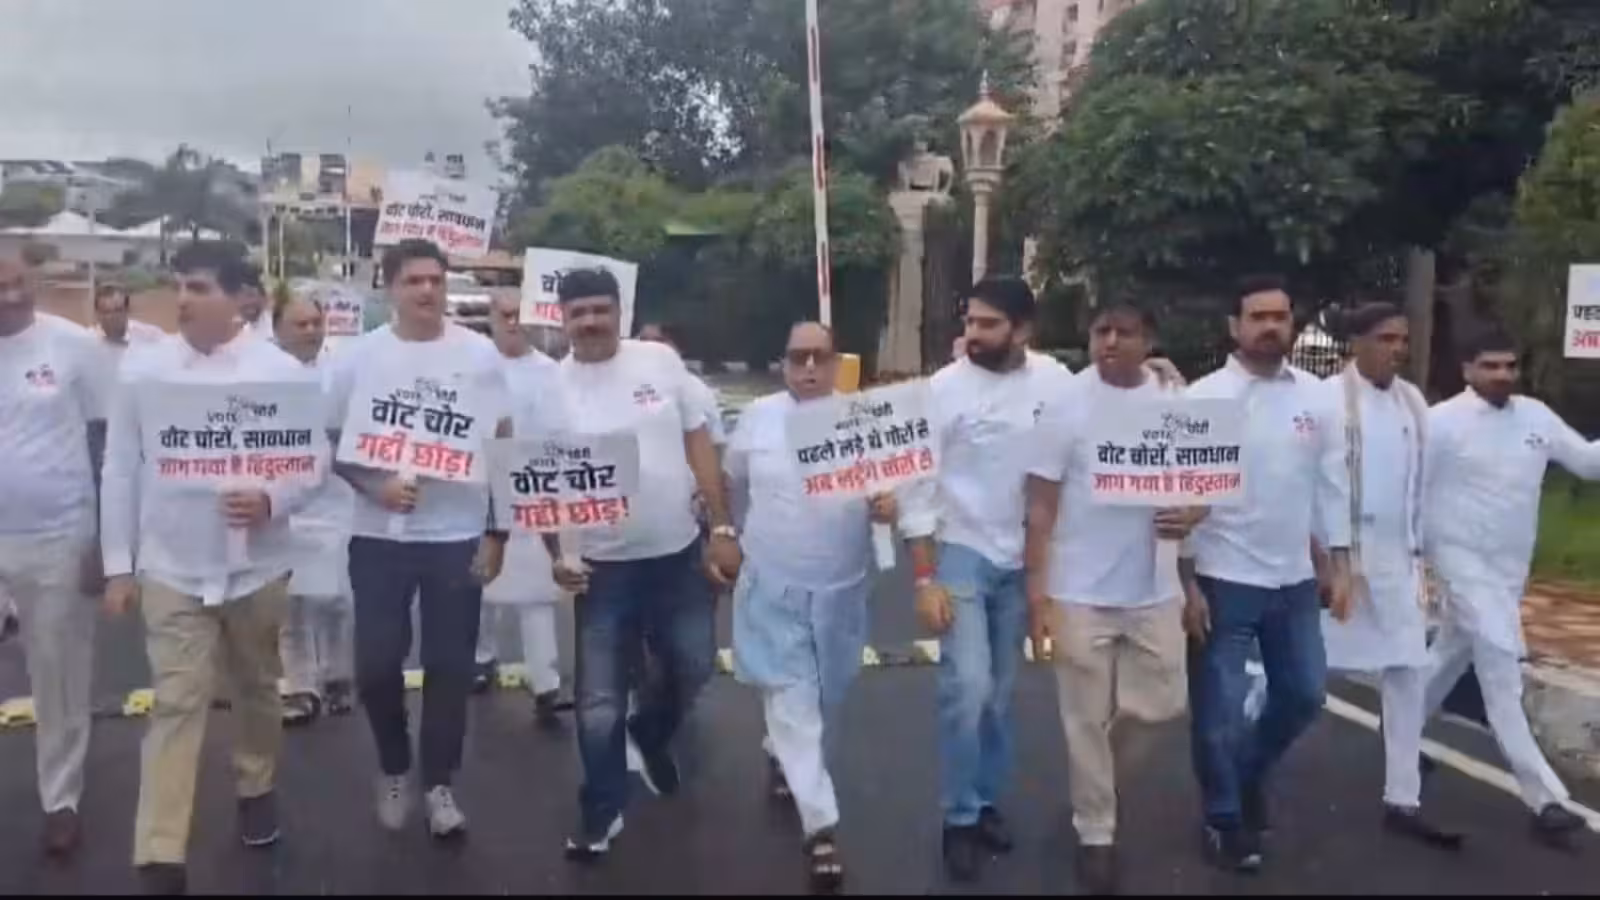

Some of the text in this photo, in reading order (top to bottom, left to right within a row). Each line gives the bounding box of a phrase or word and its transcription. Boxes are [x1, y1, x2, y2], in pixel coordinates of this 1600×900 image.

[371, 393, 475, 439] वोट चोर
[159, 425, 190, 449] वोट
[241, 428, 312, 449] सावधान
[356, 431, 407, 462] गद्दी
[797, 438, 835, 464] पहले
[1097, 441, 1240, 466] वोट चोरों, सावधान
[509, 461, 617, 494] वोट चोर
[1178, 470, 1241, 496] हिंदुस्तान
[510, 497, 560, 528] गद्दी
